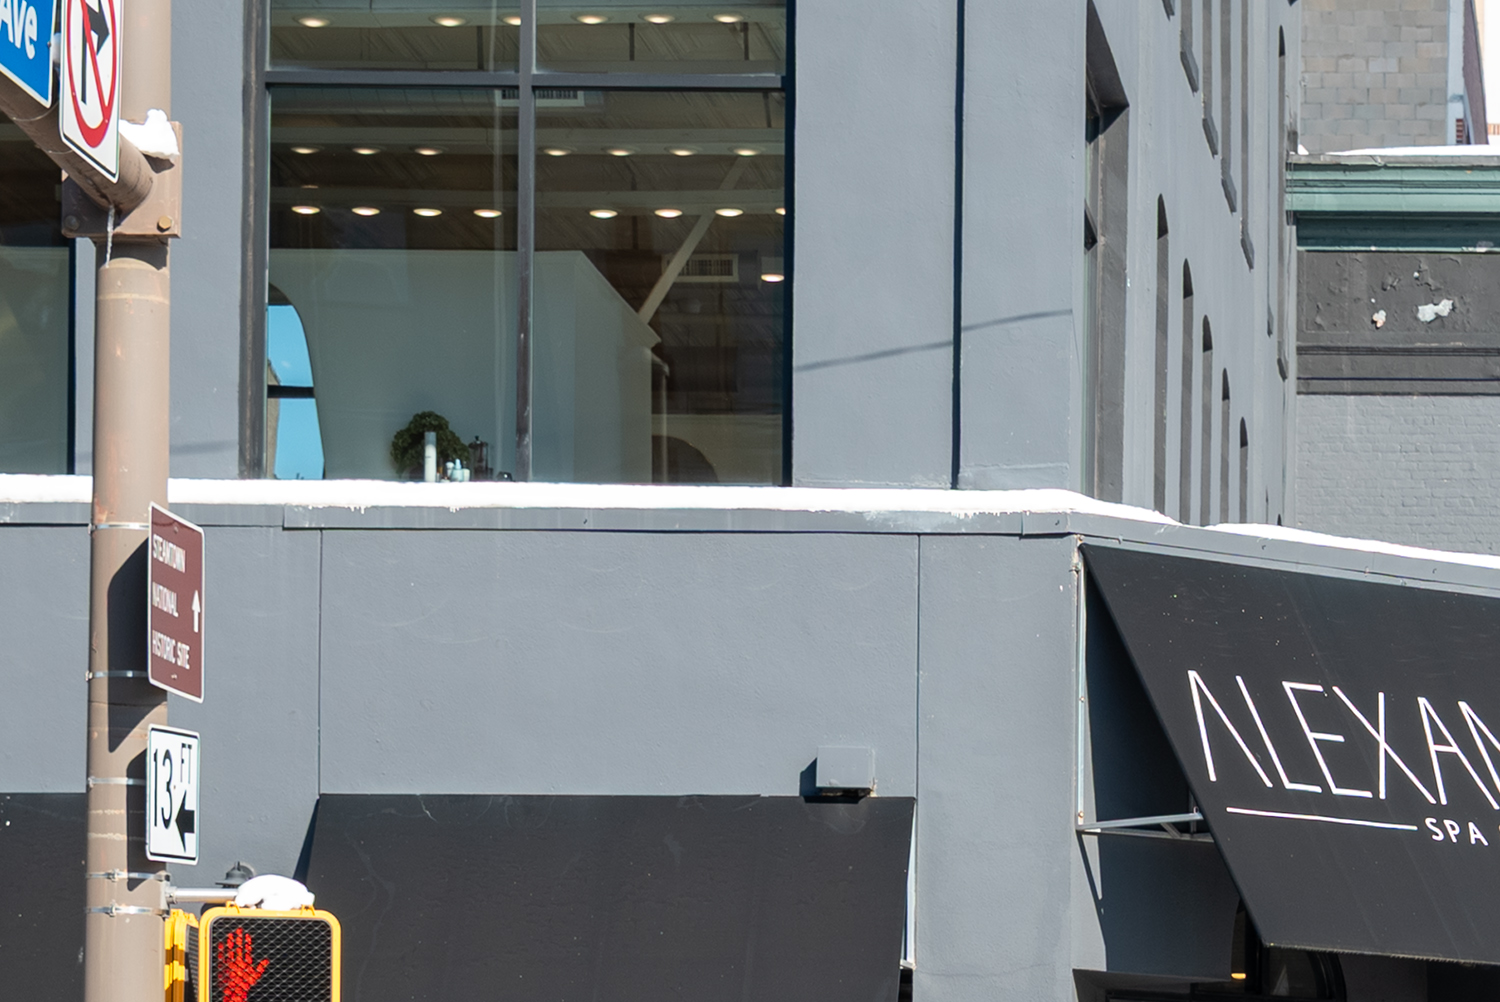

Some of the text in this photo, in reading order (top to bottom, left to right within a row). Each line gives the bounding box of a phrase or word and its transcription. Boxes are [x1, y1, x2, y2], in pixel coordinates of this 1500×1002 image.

[152, 581, 179, 618] NATIONAL
[152, 629, 190, 670] HISTORIC SITE
[153, 748, 173, 830] 13
[1424, 816, 1489, 847] SPA
